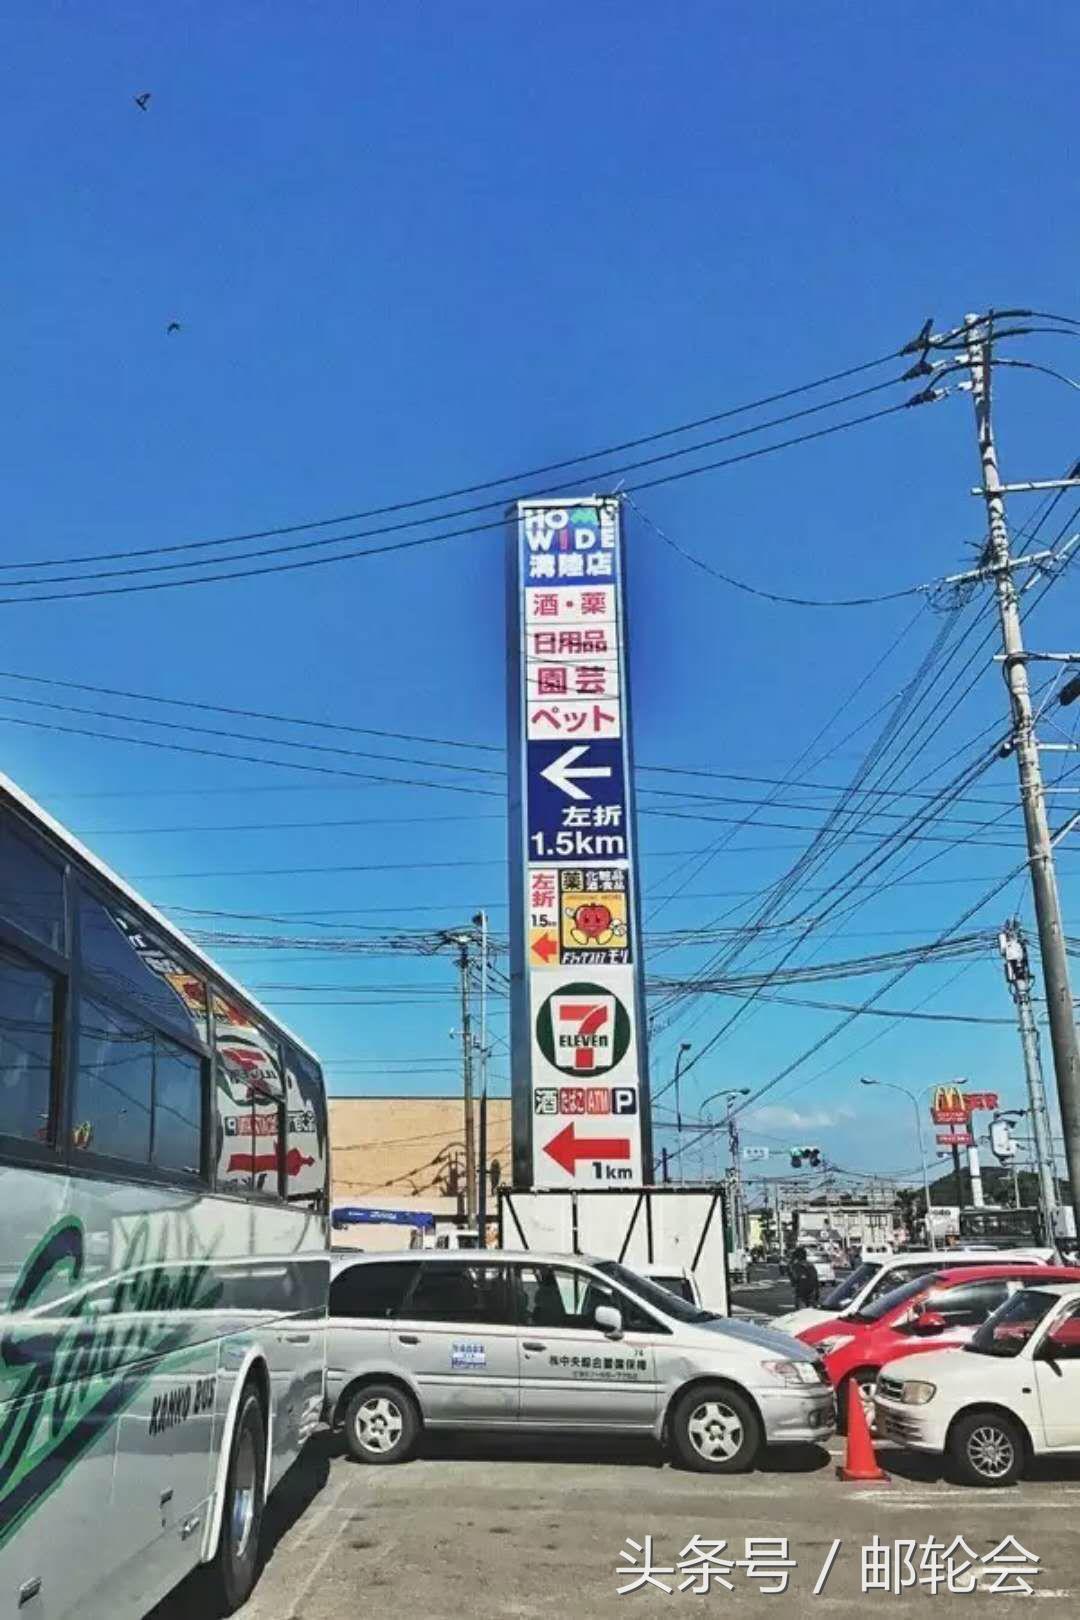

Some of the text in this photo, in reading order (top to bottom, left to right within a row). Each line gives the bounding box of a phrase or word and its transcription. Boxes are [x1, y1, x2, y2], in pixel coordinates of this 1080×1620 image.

[526, 528, 616, 551] WIDE
[534, 629, 607, 655] 日用品
[538, 666, 605, 695] 園芸
[531, 705, 615, 733] ペット
[562, 805, 622, 827] 左折
[531, 831, 624, 855] 1.5km
[533, 873, 554, 908] 左折
[559, 1004, 608, 1068] 7
[536, 1089, 557, 1113] 酒
[587, 1089, 608, 1112] ATM
[614, 1090, 633, 1113] P
